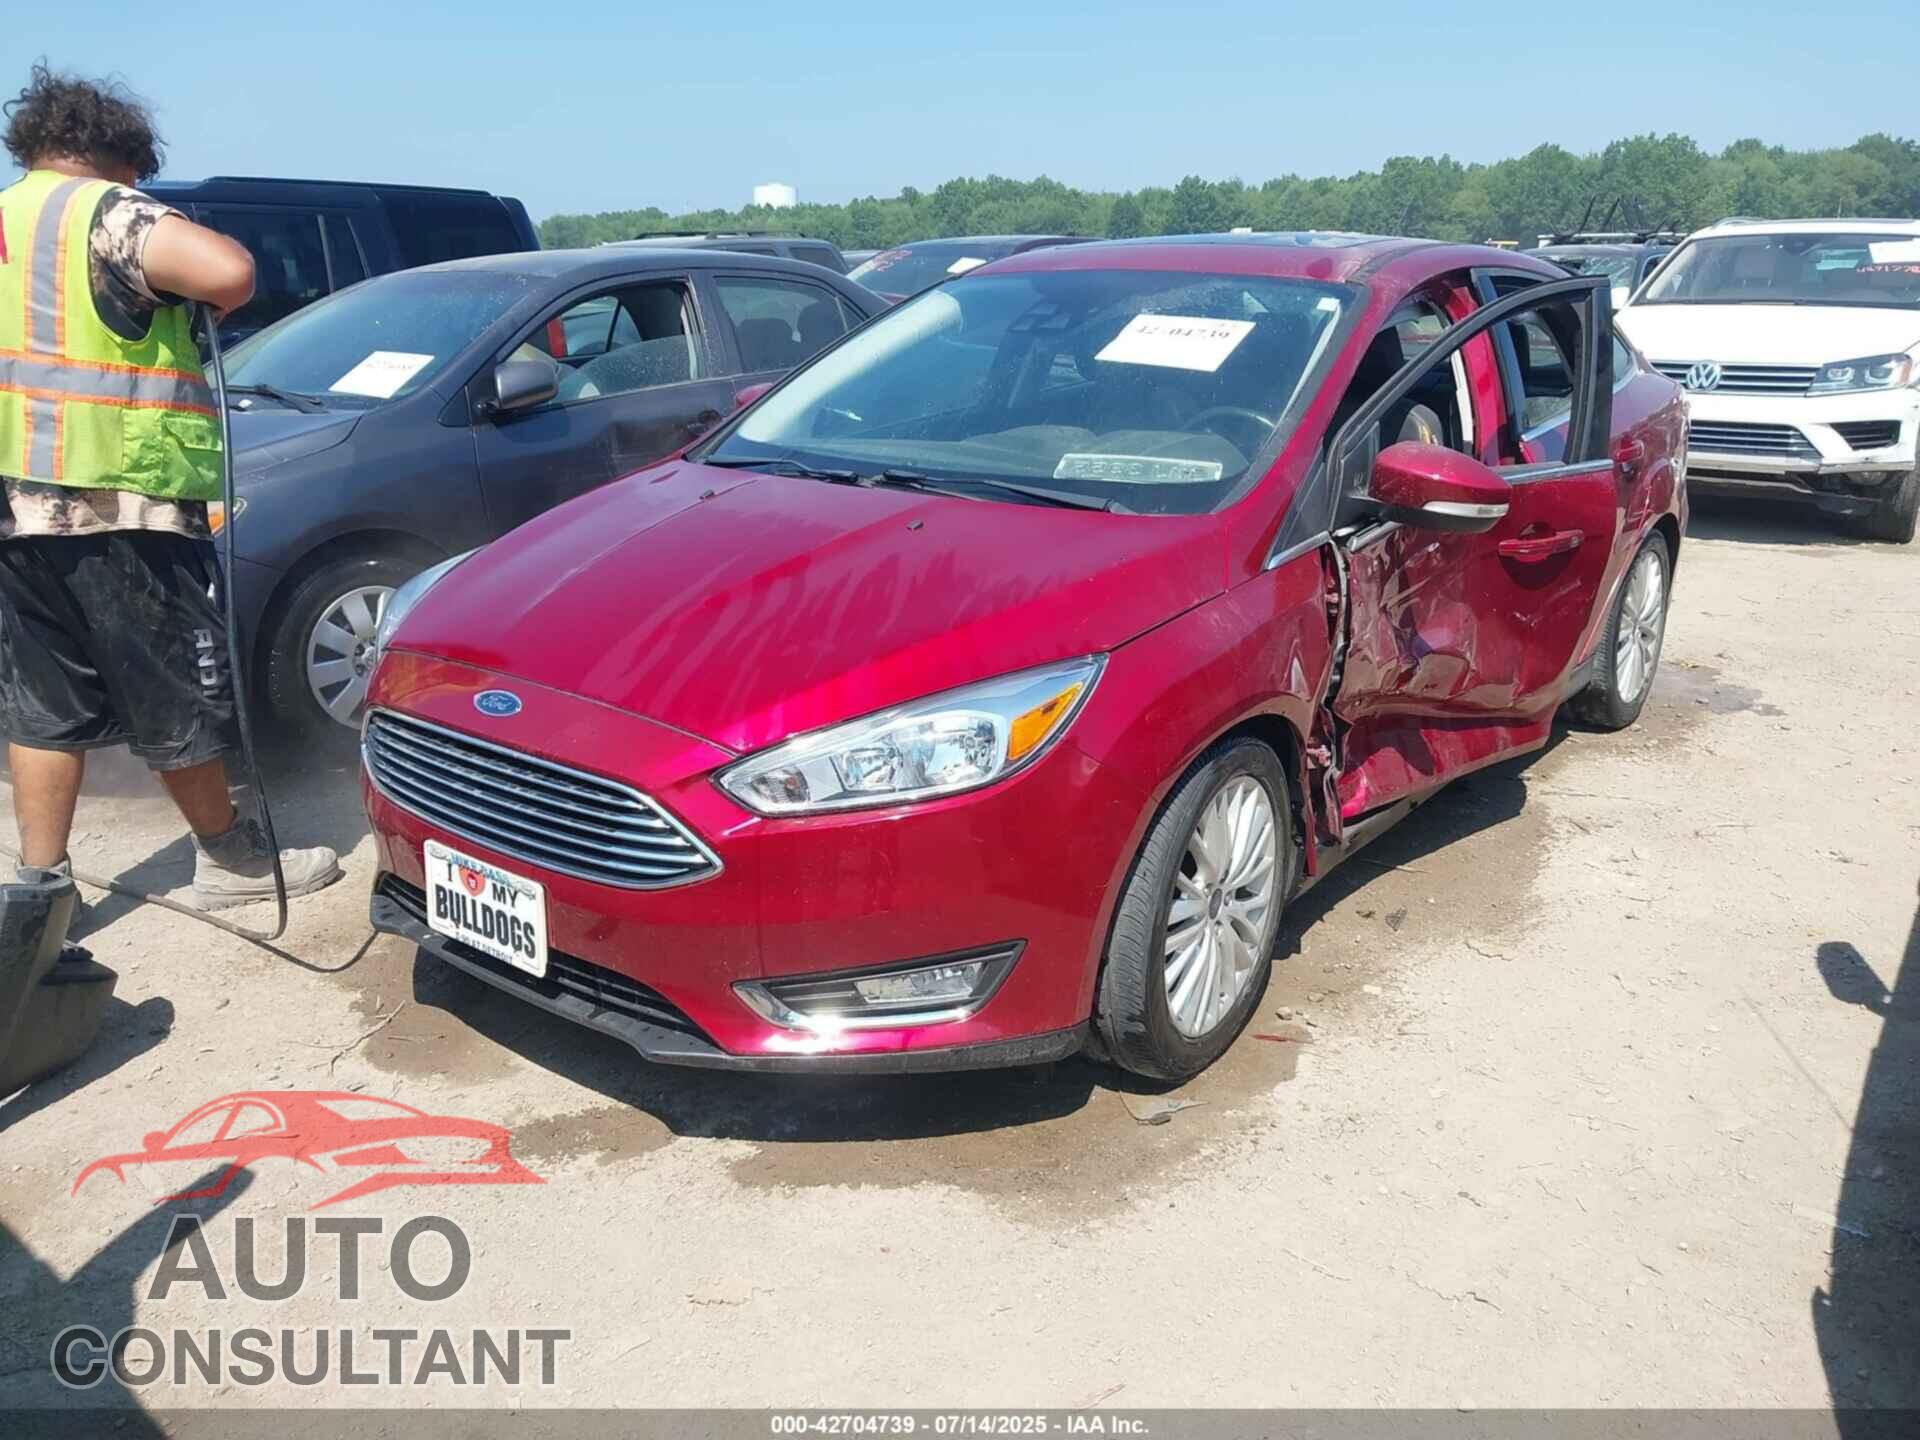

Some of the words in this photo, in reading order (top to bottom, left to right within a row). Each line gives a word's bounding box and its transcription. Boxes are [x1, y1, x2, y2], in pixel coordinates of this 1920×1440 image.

[479, 693, 517, 712] Ford
[447, 863, 452, 882] I
[492, 882, 518, 908] MY
[435, 883, 536, 959] BULLDOGS
